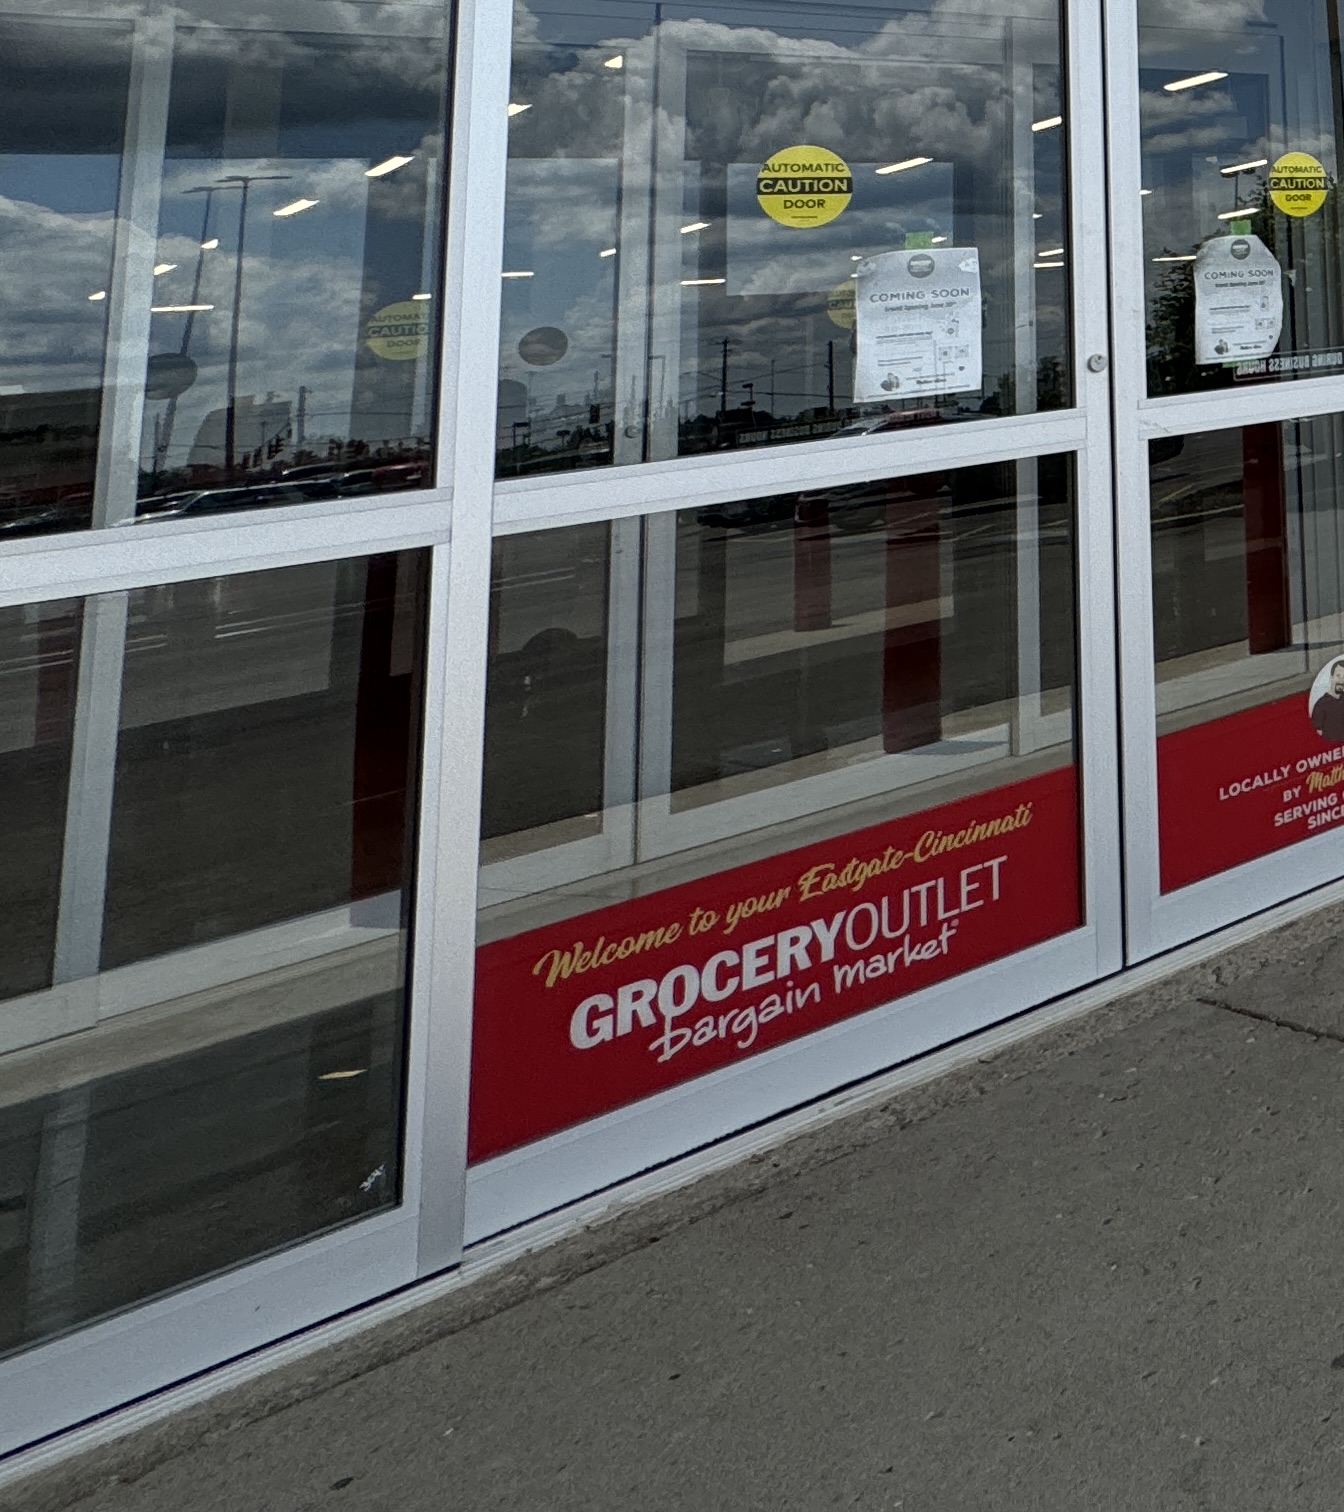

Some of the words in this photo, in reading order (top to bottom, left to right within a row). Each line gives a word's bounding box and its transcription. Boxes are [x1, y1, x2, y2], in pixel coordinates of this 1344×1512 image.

[762, 163, 846, 173] AUTOMATIC
[1272, 165, 1322, 174] AUTOMATIC
[759, 178, 848, 193] CAUTION
[1270, 178, 1325, 189] CAUTION
[783, 199, 826, 210] DOOR
[1285, 194, 1312, 202] DOOR
[1204, 270, 1244, 280] COMING
[1247, 269, 1274, 278] SOON
[869, 290, 925, 303] COMING
[931, 288, 970, 299] SOON
[371, 313, 428, 323] AUTOMAT
[368, 324, 429, 337] CAUTIO
[1219, 765, 1292, 800] LOCALLY
[1282, 785, 1301, 802] BY
[1273, 793, 1338, 827] SERVING
[532, 922, 684, 988] Welcome
[688, 908, 717, 937] to
[724, 886, 791, 936] your
[648, 984, 822, 1063] bargain
